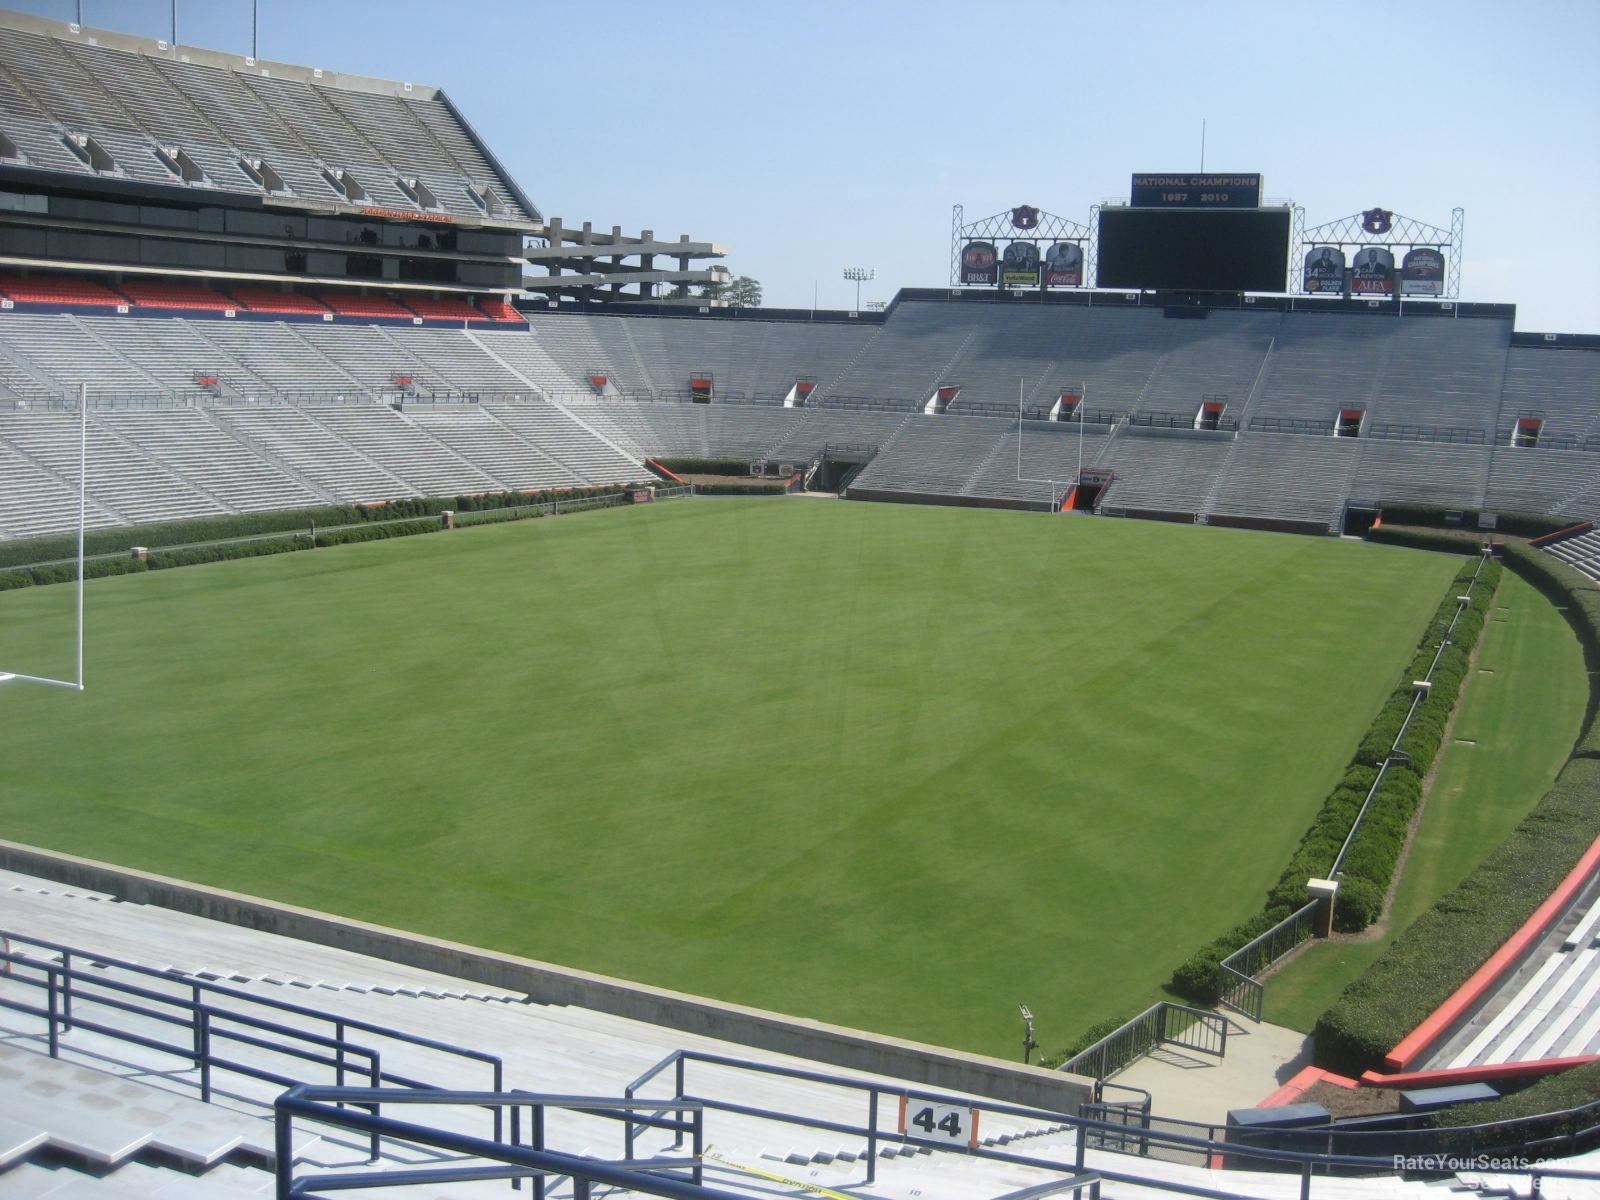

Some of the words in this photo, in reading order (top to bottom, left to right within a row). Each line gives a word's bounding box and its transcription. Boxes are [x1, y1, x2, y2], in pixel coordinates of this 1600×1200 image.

[1135, 177, 1187, 186] NATIONAL
[1190, 177, 1257, 186] CHAMPIONS
[1200, 193, 1229, 201] 2010
[967, 272, 991, 282] BB&T
[1304, 267, 1319, 278] 34
[1354, 267, 1361, 279] 2
[1358, 280, 1385, 290] ALFA
[913, 1107, 961, 1137] 44
[909, 1189, 921, 1197] 10
